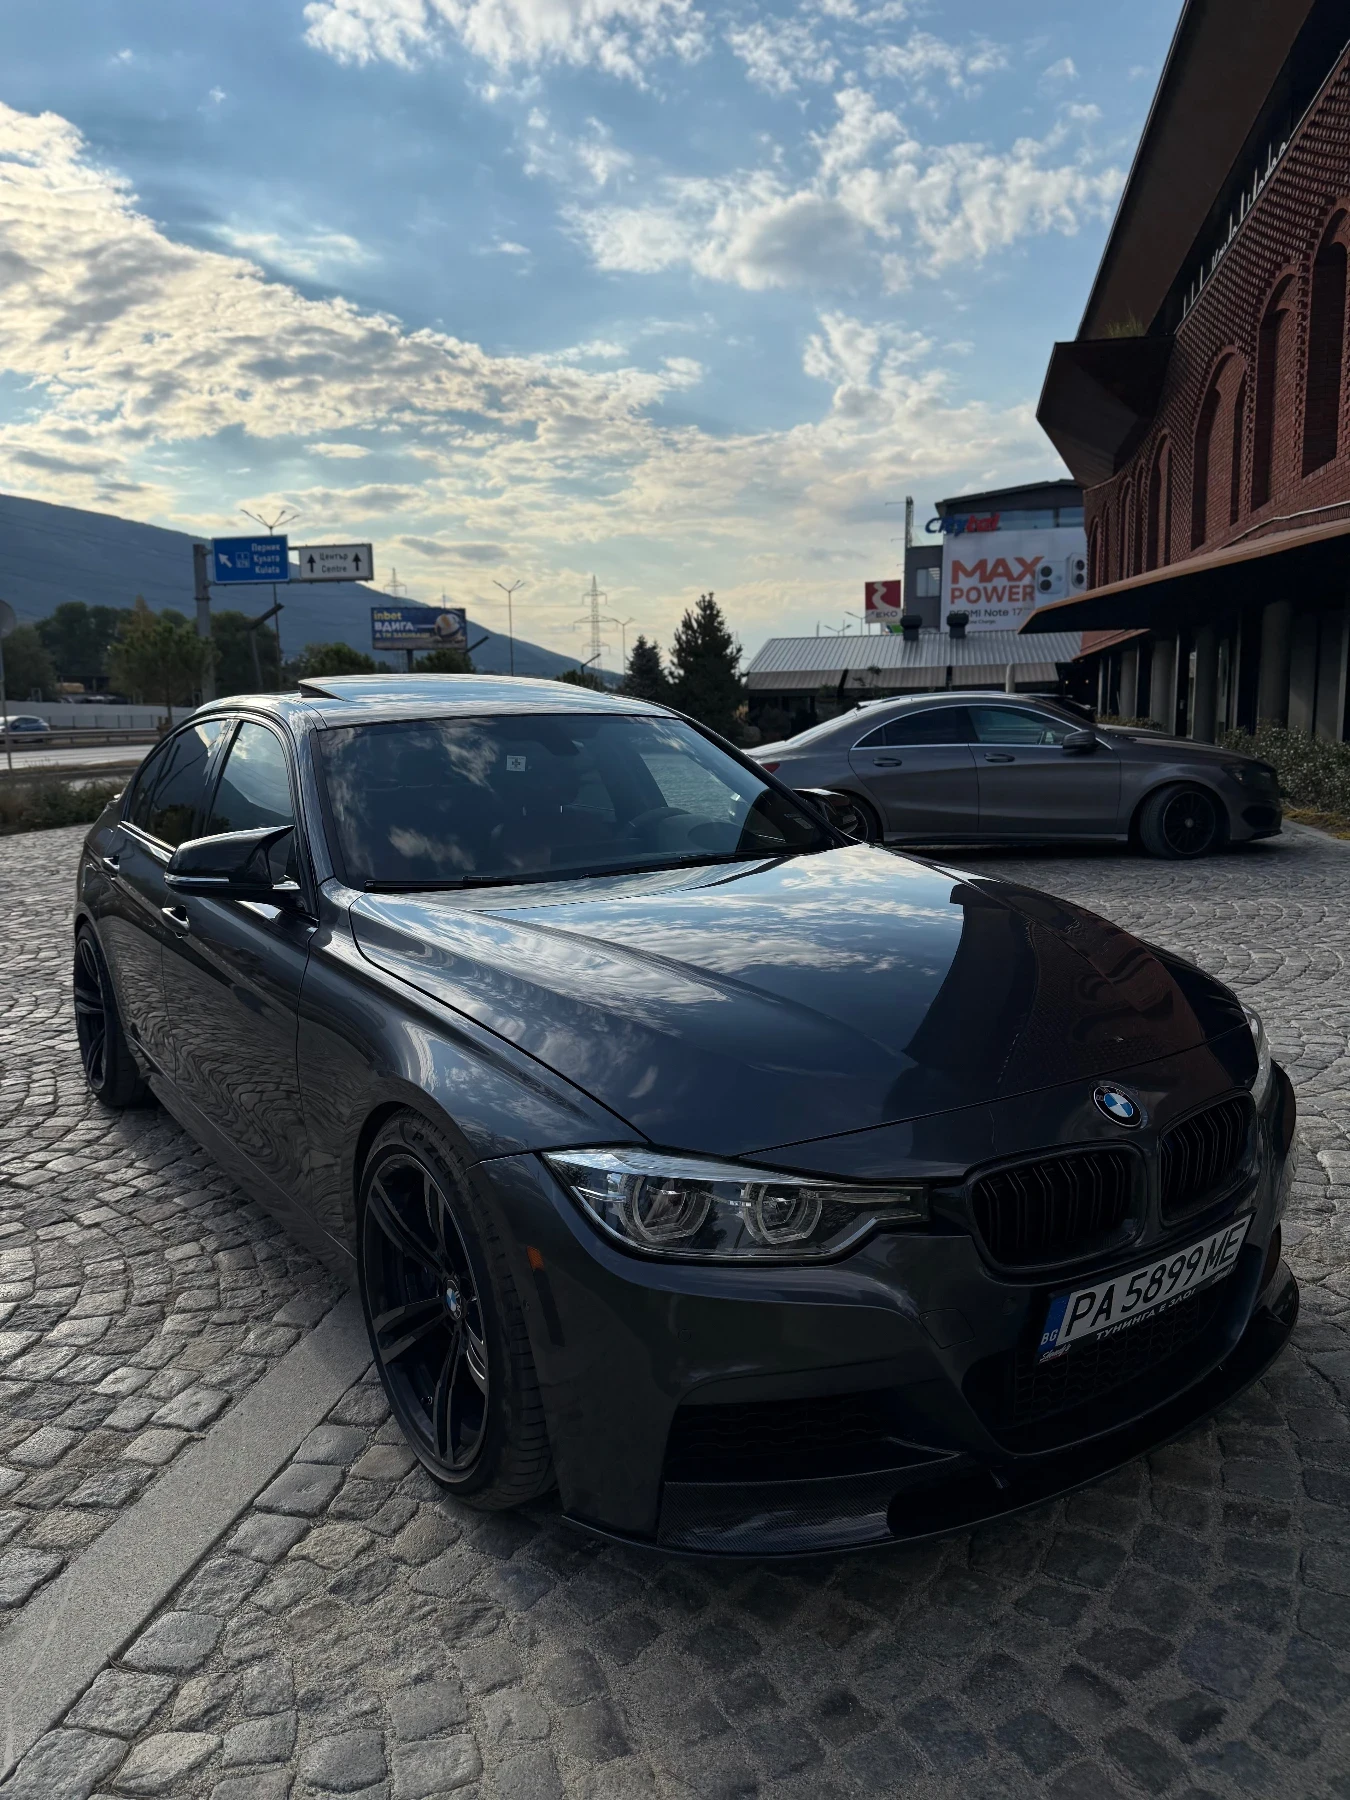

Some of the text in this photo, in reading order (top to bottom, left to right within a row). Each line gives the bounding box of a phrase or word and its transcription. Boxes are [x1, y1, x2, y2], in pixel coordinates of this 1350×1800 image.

[251, 543, 280, 553] Перник
[253, 554, 280, 565] Кулата
[319, 552, 348, 562] Център
[255, 565, 280, 574] Kulata
[321, 564, 347, 573] Centre
[951, 556, 1045, 585] MAX
[950, 585, 1035, 605] POWER
[373, 610, 402, 621] inbet
[875, 610, 898, 619] EKO
[984, 608, 1009, 617] Note
[1121, 1245, 1205, 1313] 5899
[1096, 1309, 1155, 1341] ТУНИНГА
[1040, 1328, 1059, 1346] BG
